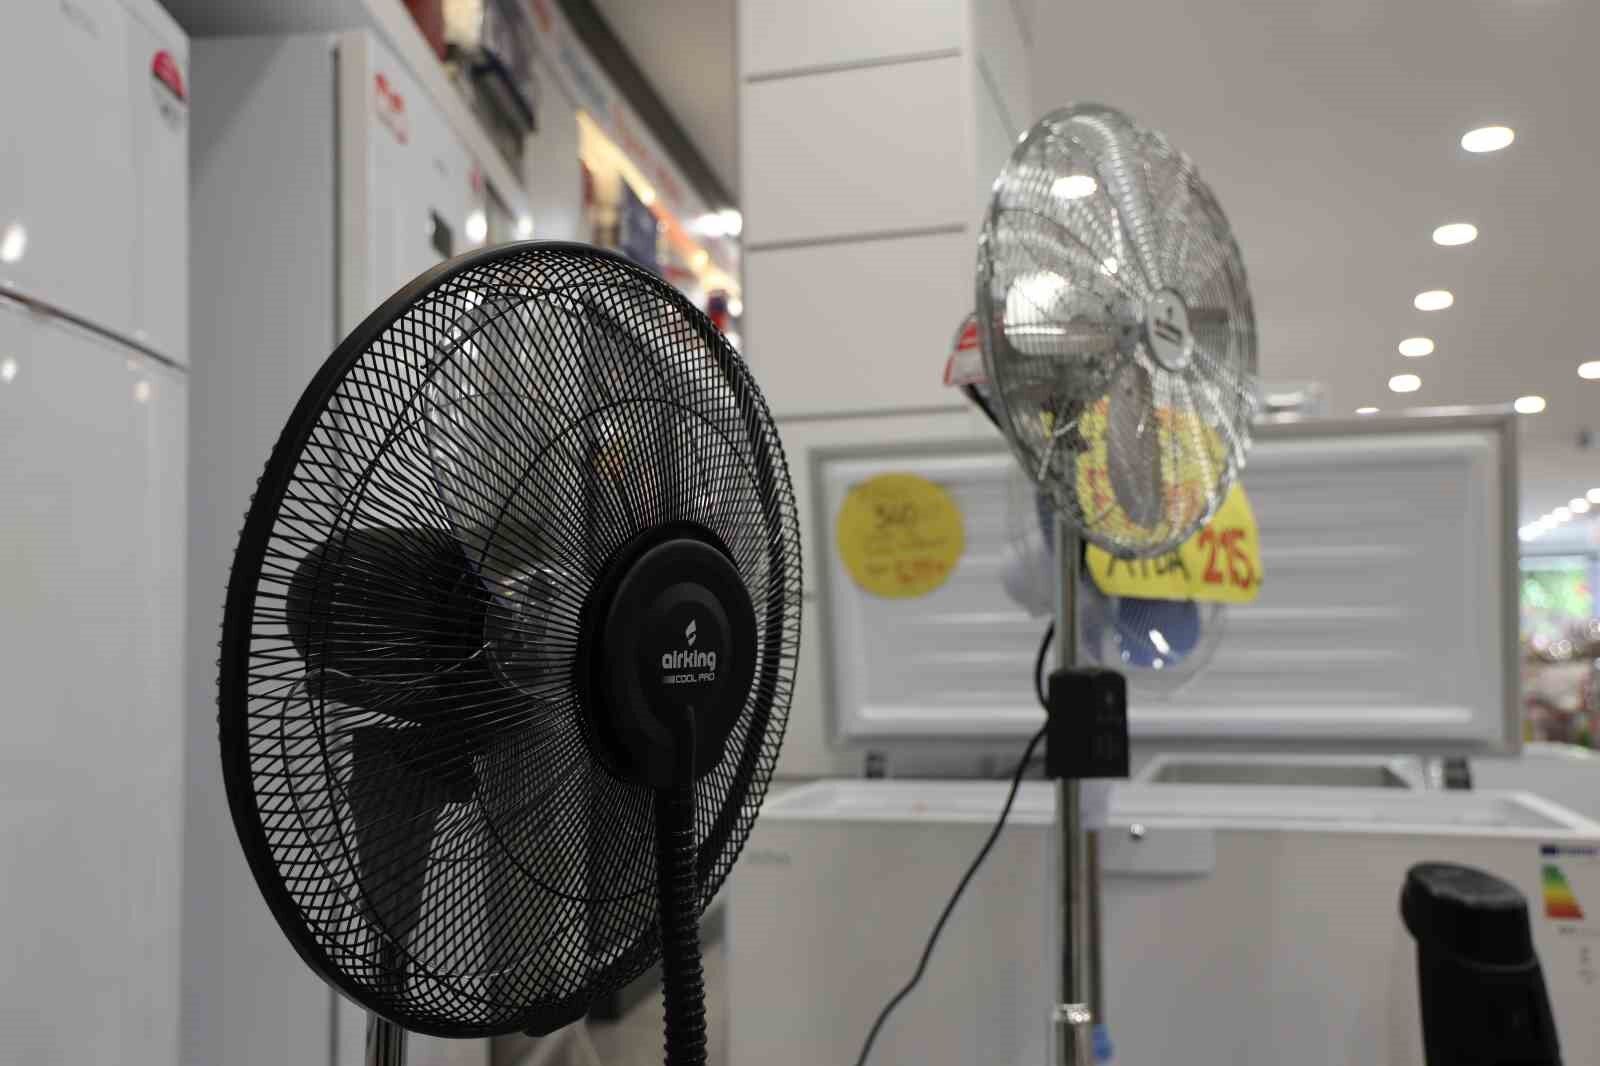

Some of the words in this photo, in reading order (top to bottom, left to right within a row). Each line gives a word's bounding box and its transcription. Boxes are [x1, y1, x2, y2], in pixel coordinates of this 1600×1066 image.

[662, 649, 716, 671] airking
[675, 674, 697, 684] COOL
[698, 672, 715, 682] PRO
